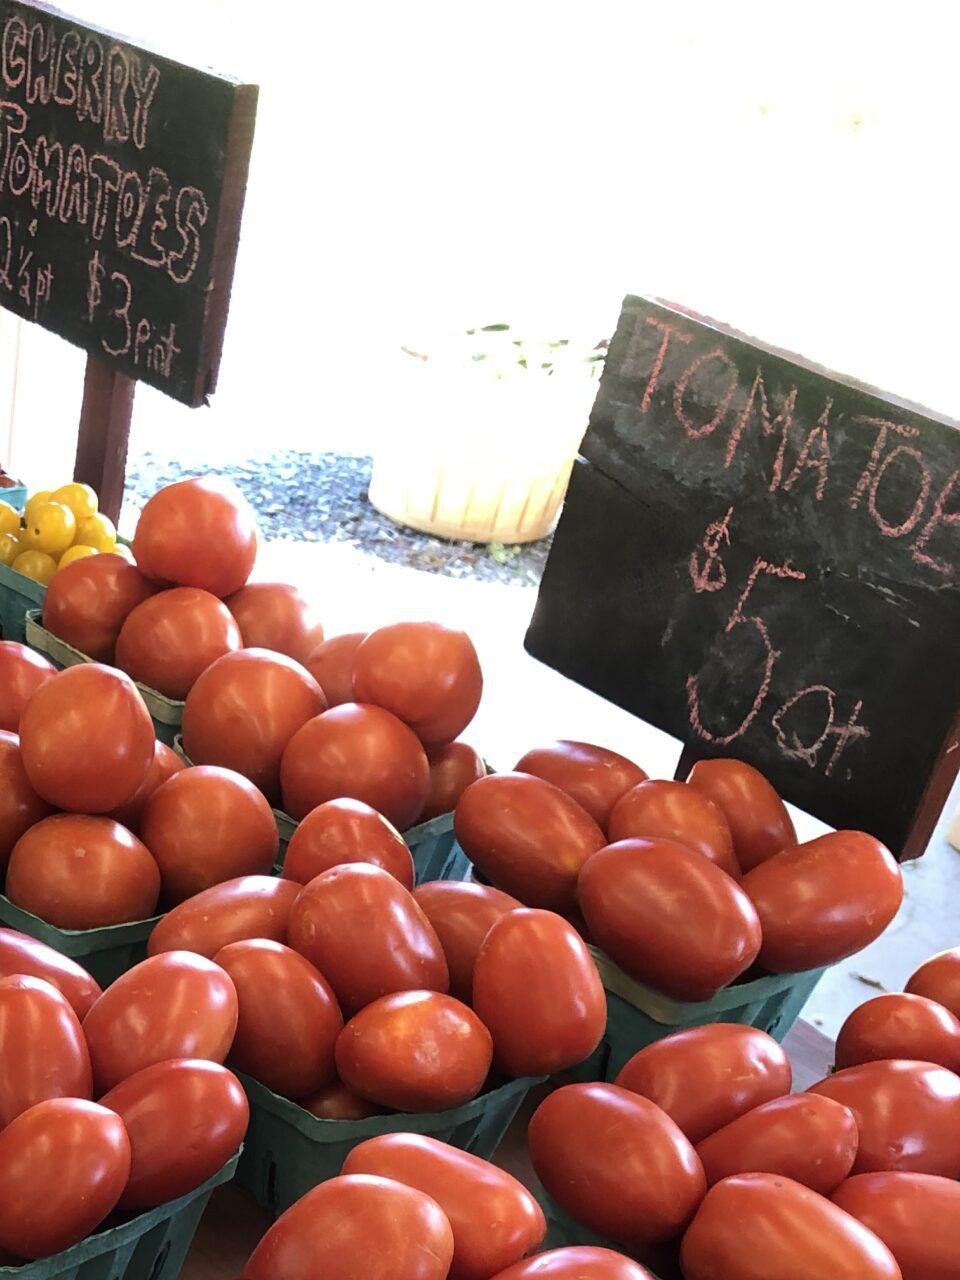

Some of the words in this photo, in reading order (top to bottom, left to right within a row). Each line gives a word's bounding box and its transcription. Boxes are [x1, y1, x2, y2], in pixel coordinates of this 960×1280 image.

[1, 15, 160, 150] CHERRY
[87, 249, 132, 357] $3
[685, 505, 807, 746] $5
